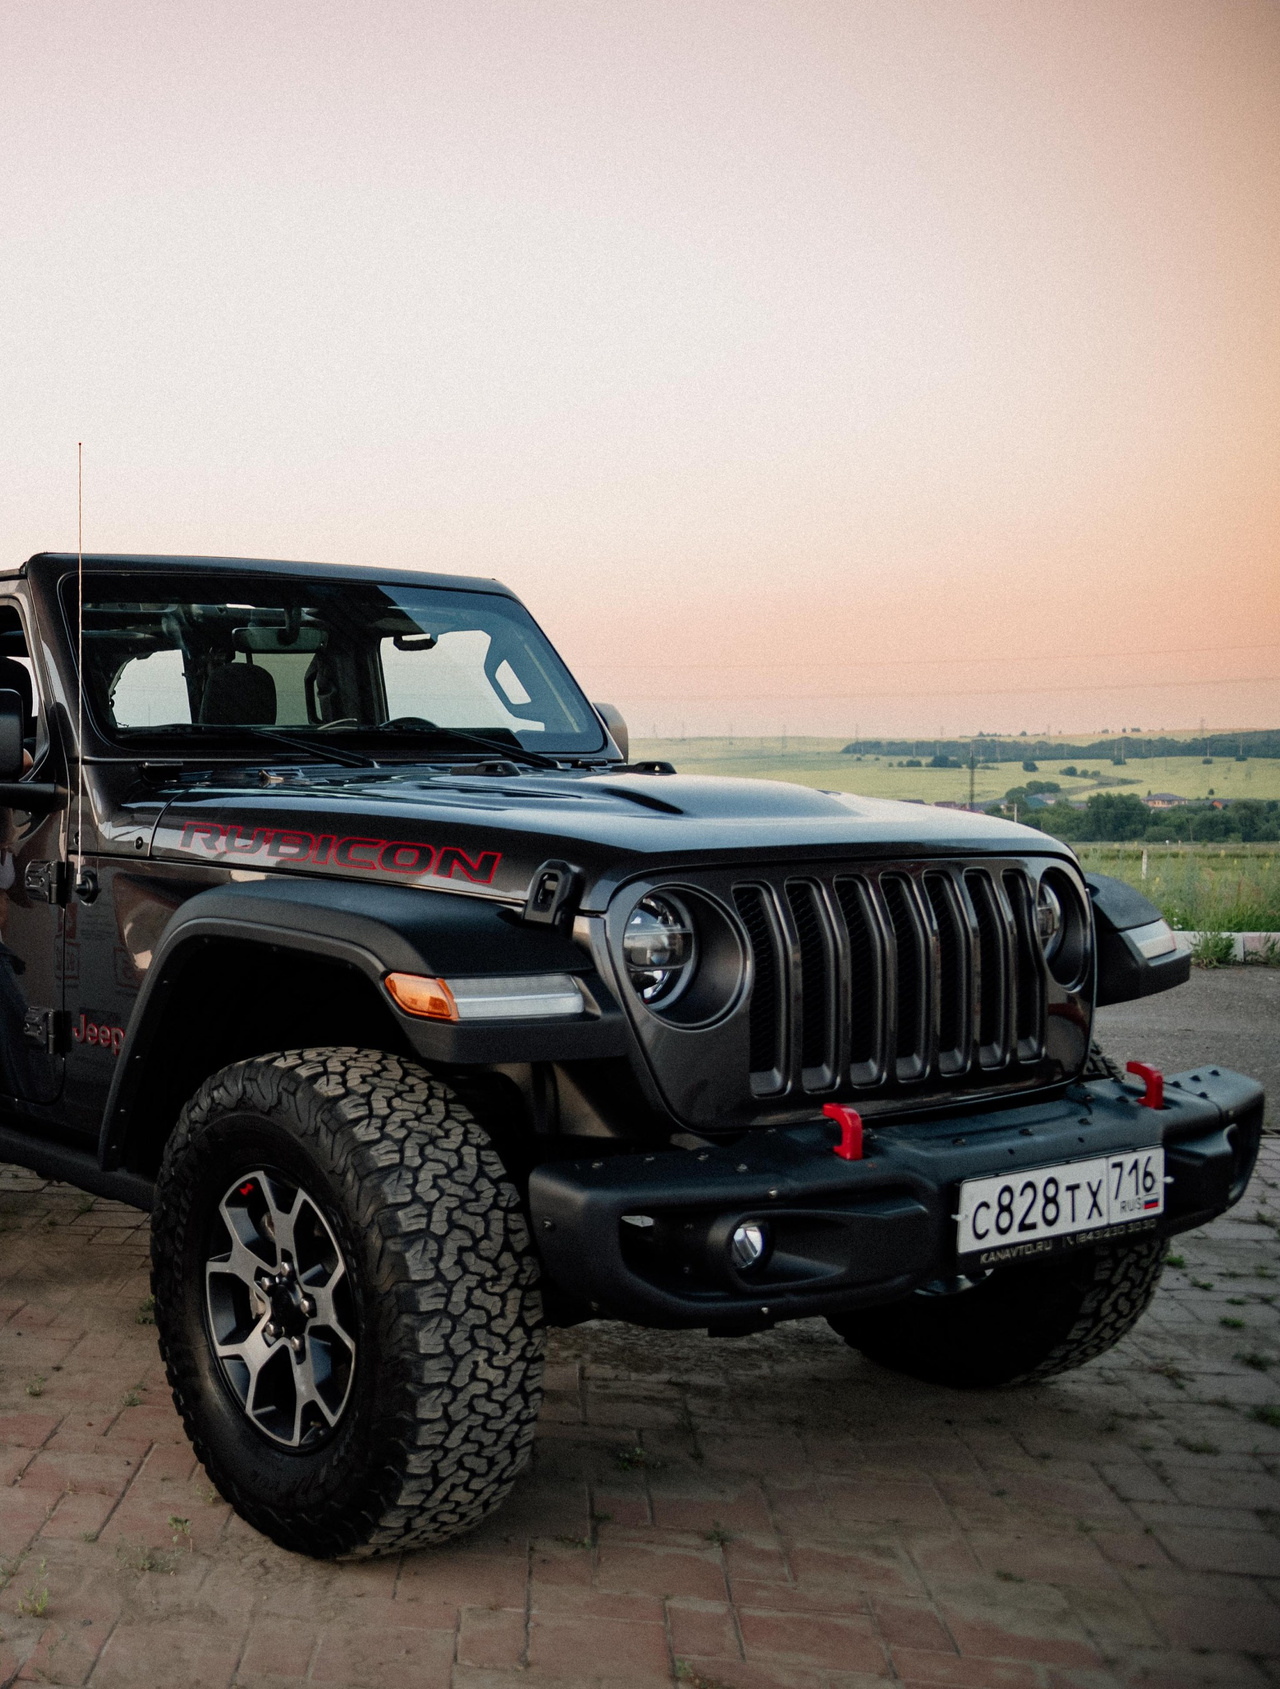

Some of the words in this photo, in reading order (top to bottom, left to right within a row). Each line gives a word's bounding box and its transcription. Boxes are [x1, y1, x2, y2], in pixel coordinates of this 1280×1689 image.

[178, 821, 502, 884] RUBICON
[72, 1014, 125, 1056] Jeep
[1111, 1156, 1156, 1200] 716
[1121, 1197, 1142, 1212] RUS
[980, 1240, 1053, 1264] KANAVTO.RU
